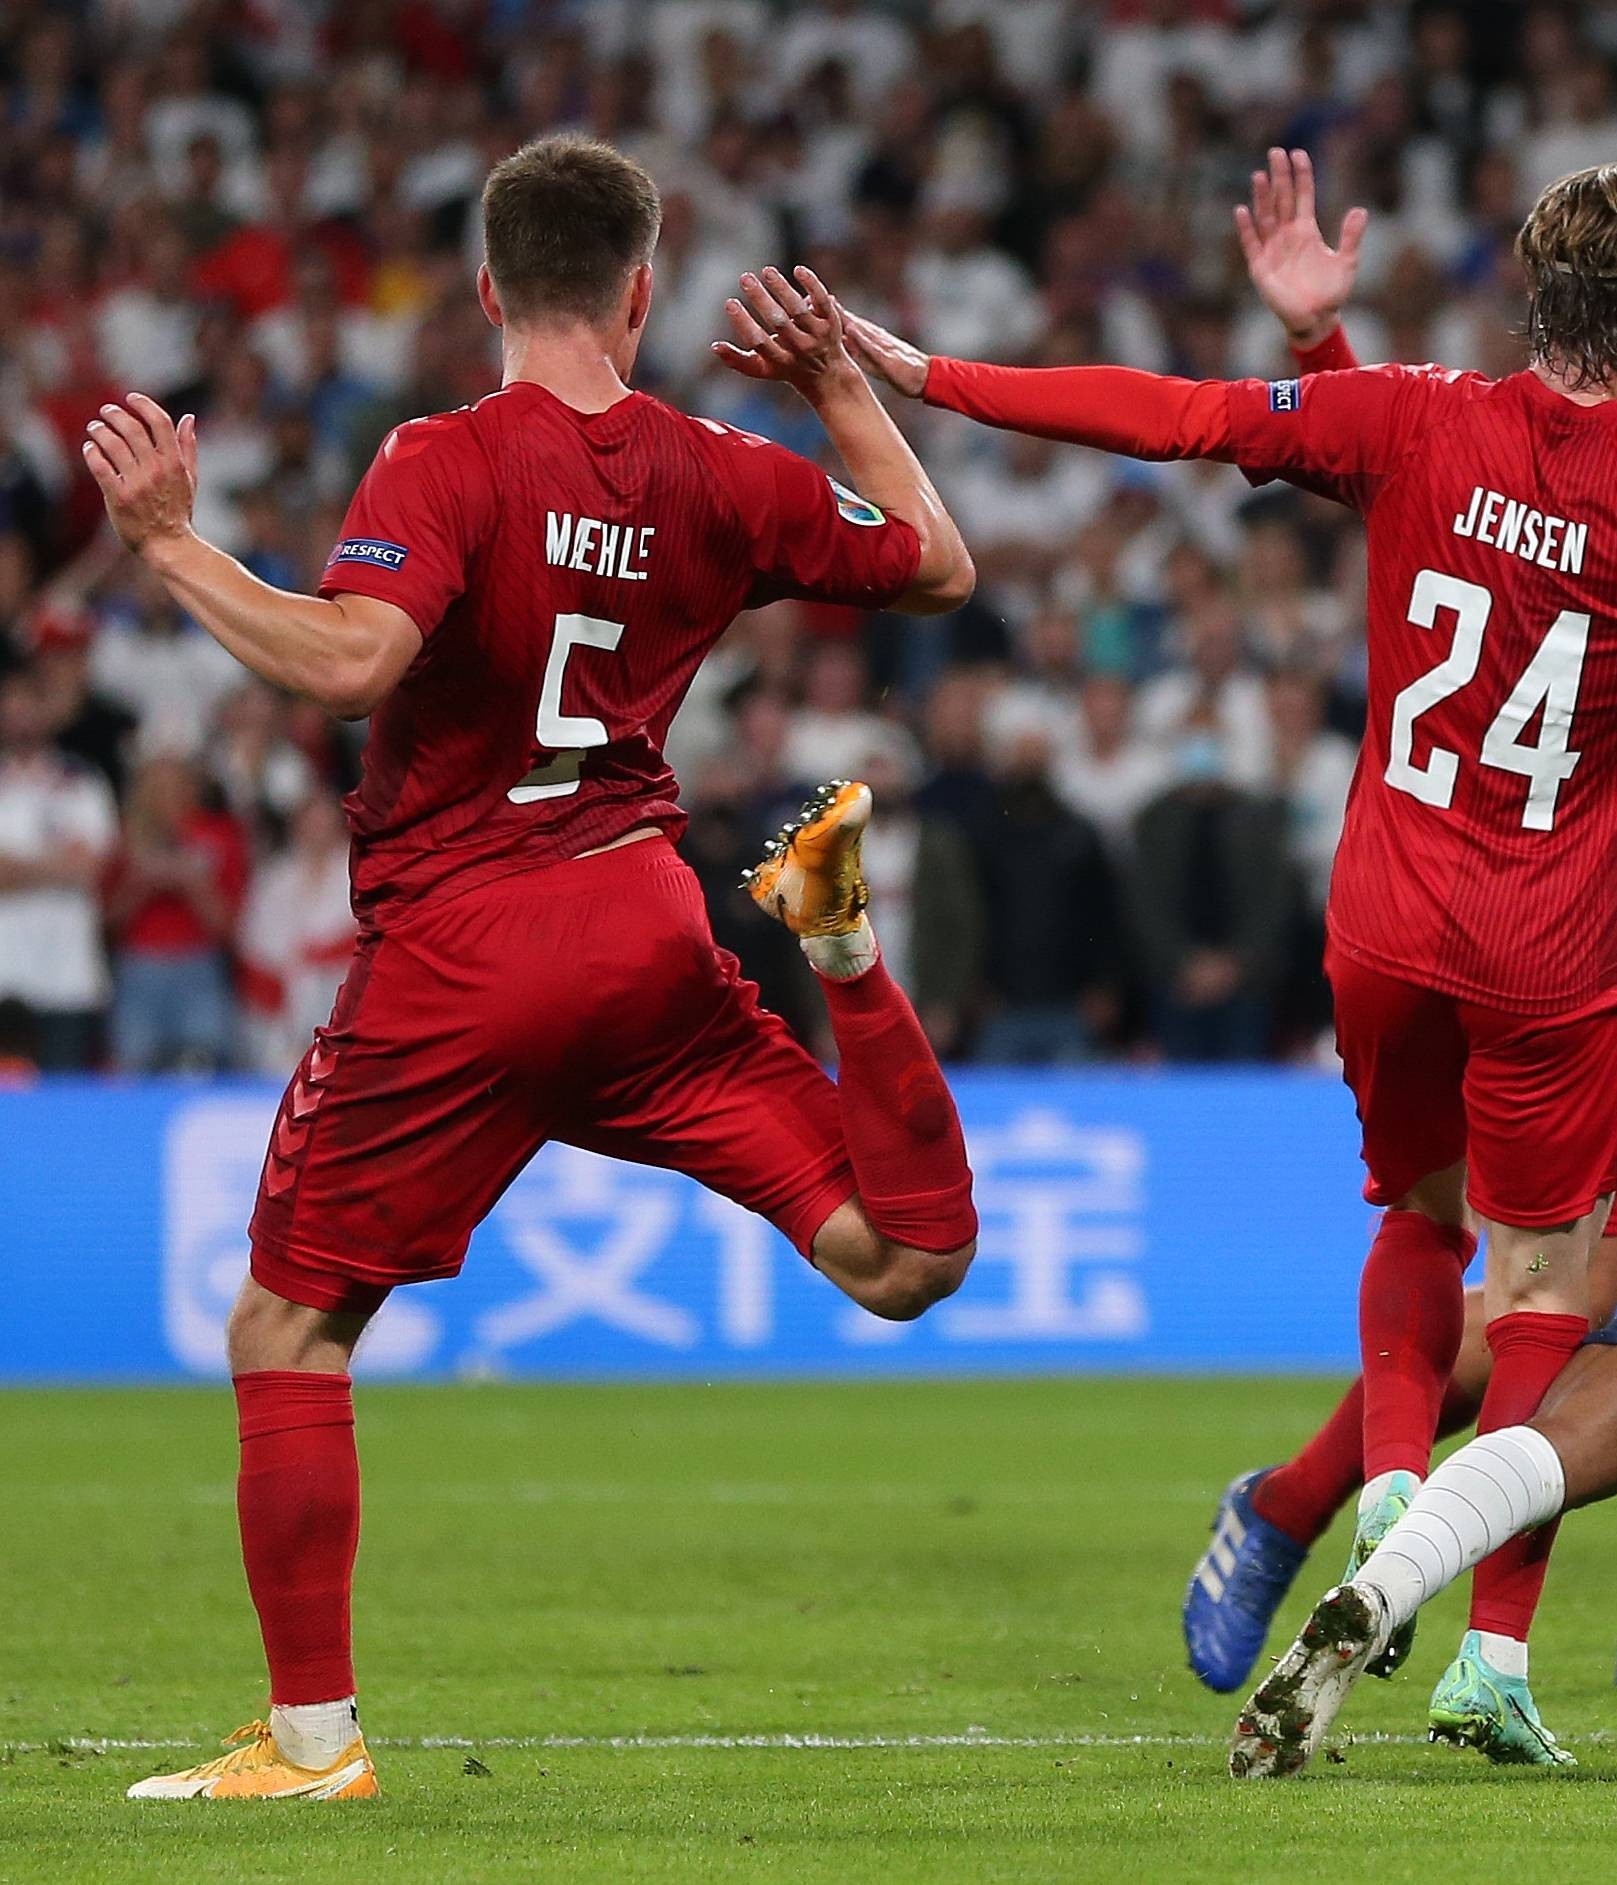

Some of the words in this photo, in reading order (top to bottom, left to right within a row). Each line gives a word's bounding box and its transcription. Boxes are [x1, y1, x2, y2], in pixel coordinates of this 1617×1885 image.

[1277, 380, 1291, 410] SPECT
[341, 544, 405, 564] RESPECT
[546, 511, 656, 580] MÆHLE
[1453, 487, 1588, 574] JENSEN
[506, 613, 625, 804] 5
[1384, 568, 1592, 832] 24
